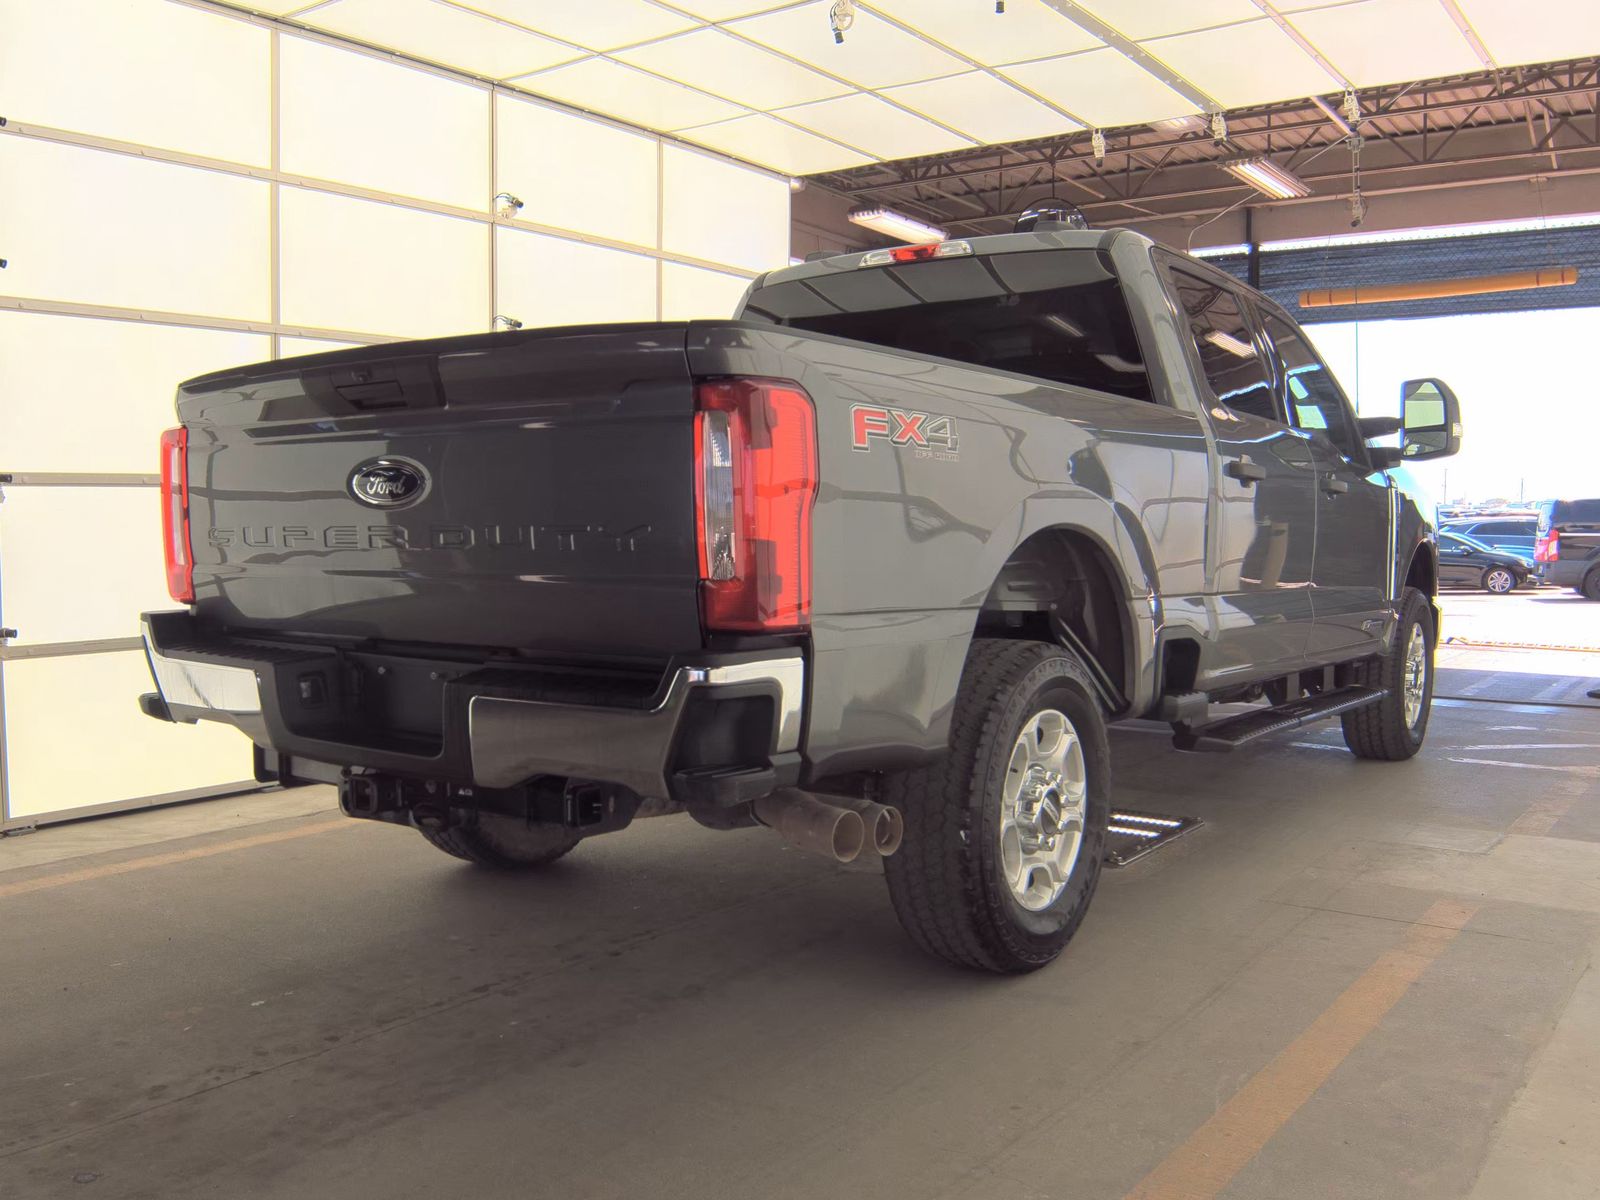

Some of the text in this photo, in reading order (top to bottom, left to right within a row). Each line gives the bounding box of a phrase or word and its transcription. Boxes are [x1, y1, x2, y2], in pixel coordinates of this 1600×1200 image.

[849, 402, 960, 453] FX4
[366, 470, 407, 495] Ford
[208, 524, 653, 552] SUPER DUTY
